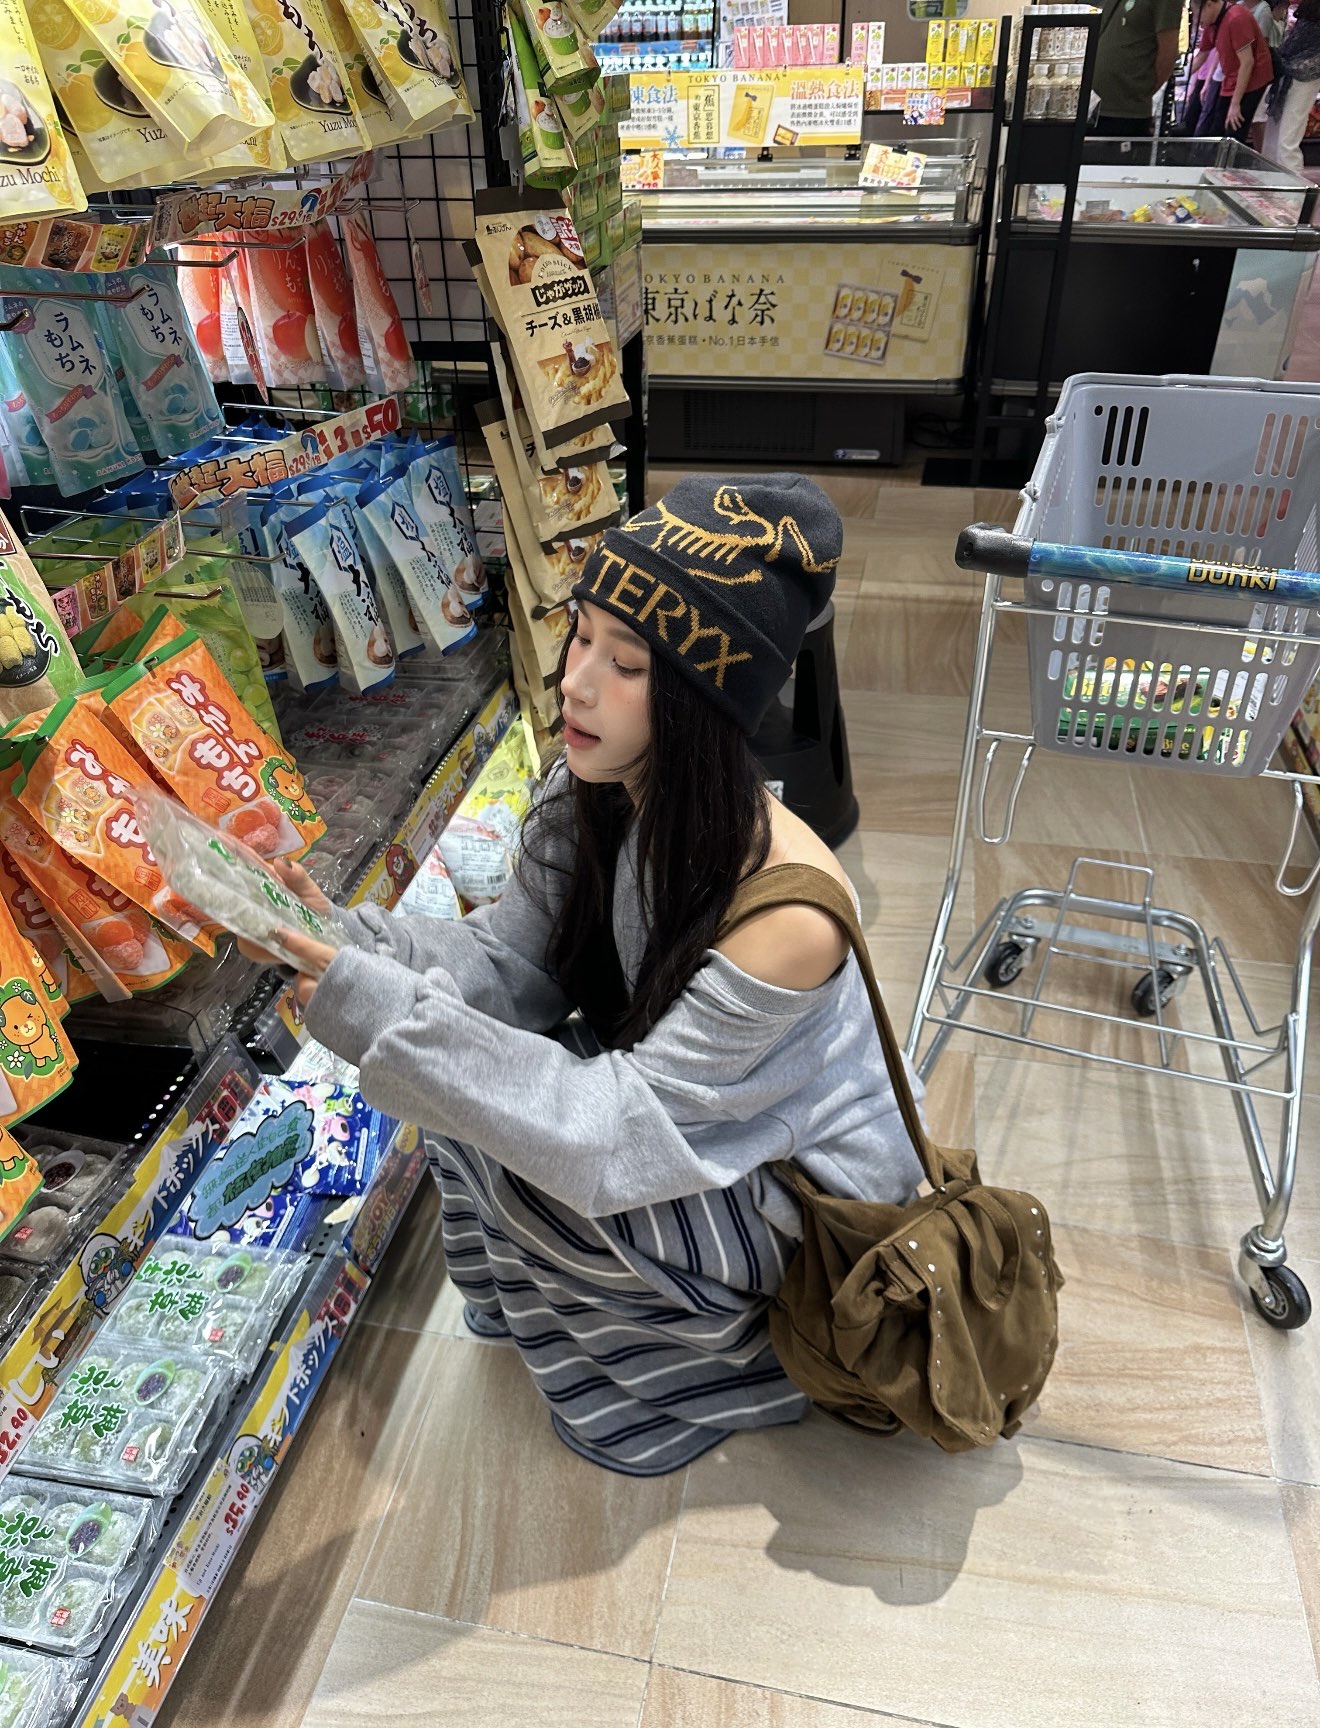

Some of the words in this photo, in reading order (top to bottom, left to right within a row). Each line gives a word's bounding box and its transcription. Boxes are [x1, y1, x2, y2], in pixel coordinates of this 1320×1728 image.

[688, 75, 727, 83] TOKYO
[733, 73, 781, 82] BANANA
[791, 80, 859, 100] 溫熱食法
[319, 119, 344, 133] Yuzu
[16, 166, 60, 186] Mochi
[536, 280, 586, 304] じゃがザック
[703, 274, 785, 284] BANANA
[140, 305, 166, 343] もち
[644, 287, 778, 327] 東京ばな奈
[44, 330, 76, 372] もち
[54, 312, 97, 375] ラムネ
[363, 398, 400, 440] $50
[1187, 562, 1279, 592] DONKI
[589, 548, 753, 690] TERYX
[170, 673, 260, 765] みかん
[70, 743, 132, 794] みか
[192, 738, 258, 800] もち
[128, 1120, 220, 1253] ギフトボックス
[149, 1287, 210, 1321] 草餅
[266, 1313, 338, 1449] ギフトボックス
[59, 1398, 127, 1439] 草餅
[0, 1511, 55, 1546] 治と
[225, 1483, 251, 1537] $35.90
[132, 1574, 202, 1690] 美味
